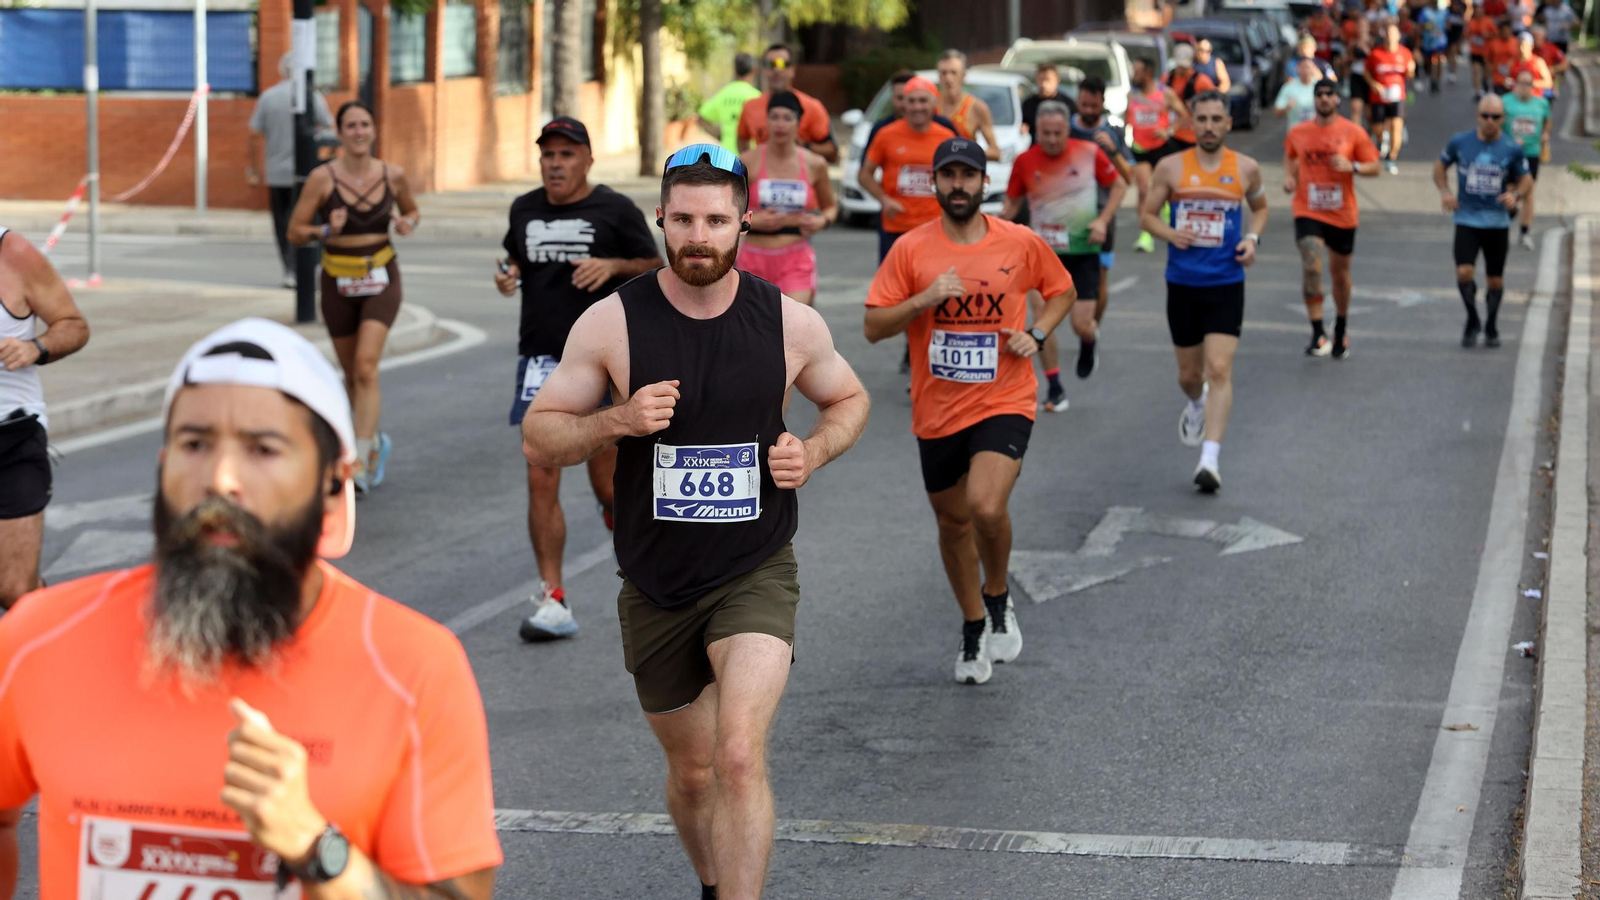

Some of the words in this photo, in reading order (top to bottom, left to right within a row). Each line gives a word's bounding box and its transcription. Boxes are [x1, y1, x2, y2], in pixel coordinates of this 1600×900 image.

[941, 348, 983, 366] 1011
[683, 458, 710, 467] XXIX
[680, 472, 734, 497] 668
[692, 505, 752, 517] MIZUNO
